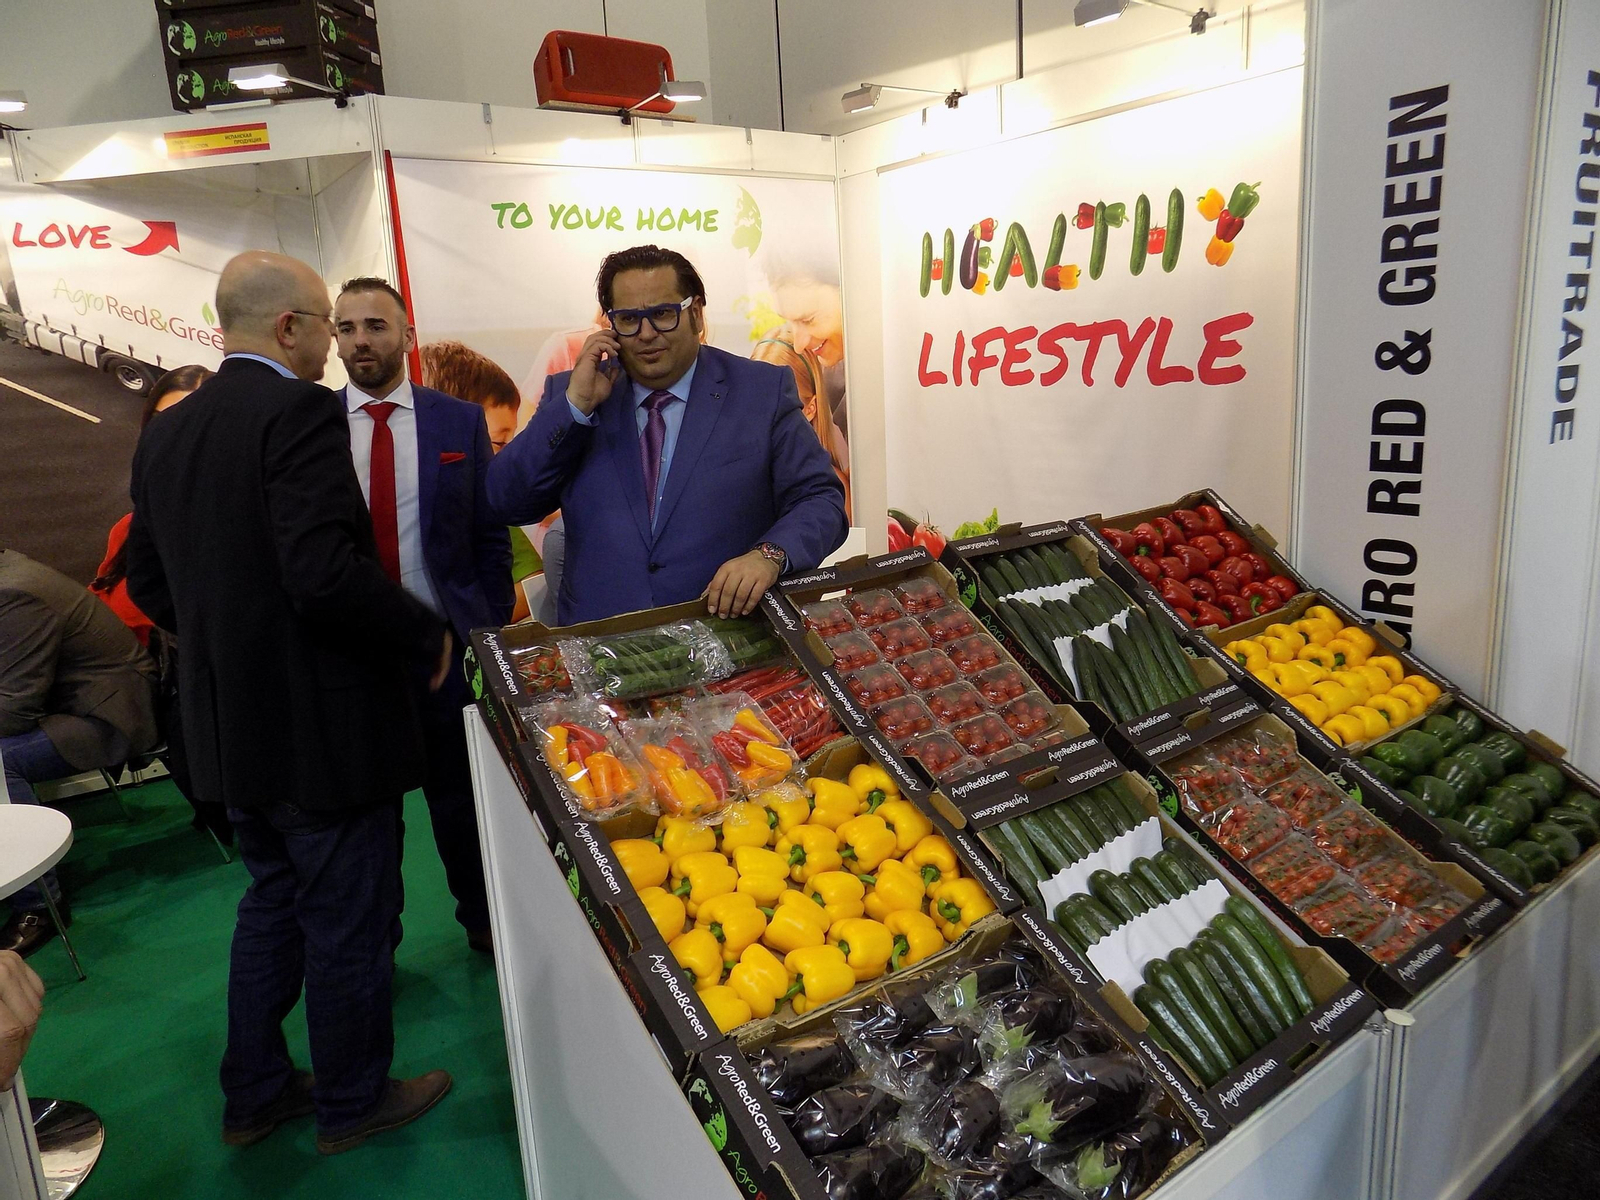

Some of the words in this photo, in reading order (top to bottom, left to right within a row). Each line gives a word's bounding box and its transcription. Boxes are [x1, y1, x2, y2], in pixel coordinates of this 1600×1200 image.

[491, 202, 533, 230] TO
[548, 203, 625, 232] YOUR
[636, 207, 719, 232] HOME
[1377, 84, 1451, 307] GREEN
[12, 222, 112, 250] LOVE
[919, 181, 1262, 298] HEALTHY
[53, 277, 224, 351] AgroRed&Gree
[918, 312, 1254, 388] LIFESTYLE
[1374, 326, 1433, 376] &
[1366, 398, 1427, 517] RED
[764, 589, 798, 631] AgroRed&G
[483, 632, 519, 696] AgroRed&Green
[822, 671, 868, 728] AgroRed&Green
[869, 735, 921, 792] AgroRed&Green
[1048, 737, 1099, 762] AgroRed&Green
[1067, 759, 1118, 784] AgroRed&Green
[951, 769, 1010, 798] AgroRed&Green
[971, 793, 1030, 820] AgroRed&Green
[574, 822, 621, 895] AgroRed&Green
[956, 835, 1015, 902] AgroRed&Green
[1022, 913, 1089, 985] AgroRed&Green
[649, 953, 708, 1041] AgroRed&Green
[1310, 988, 1365, 1034] AgroRed&Green
[716, 1054, 781, 1153] AgroRed&Green
[1139, 1040, 1216, 1130] AgroRed&Green
[1218, 1057, 1279, 1109] AgroRed&Green
